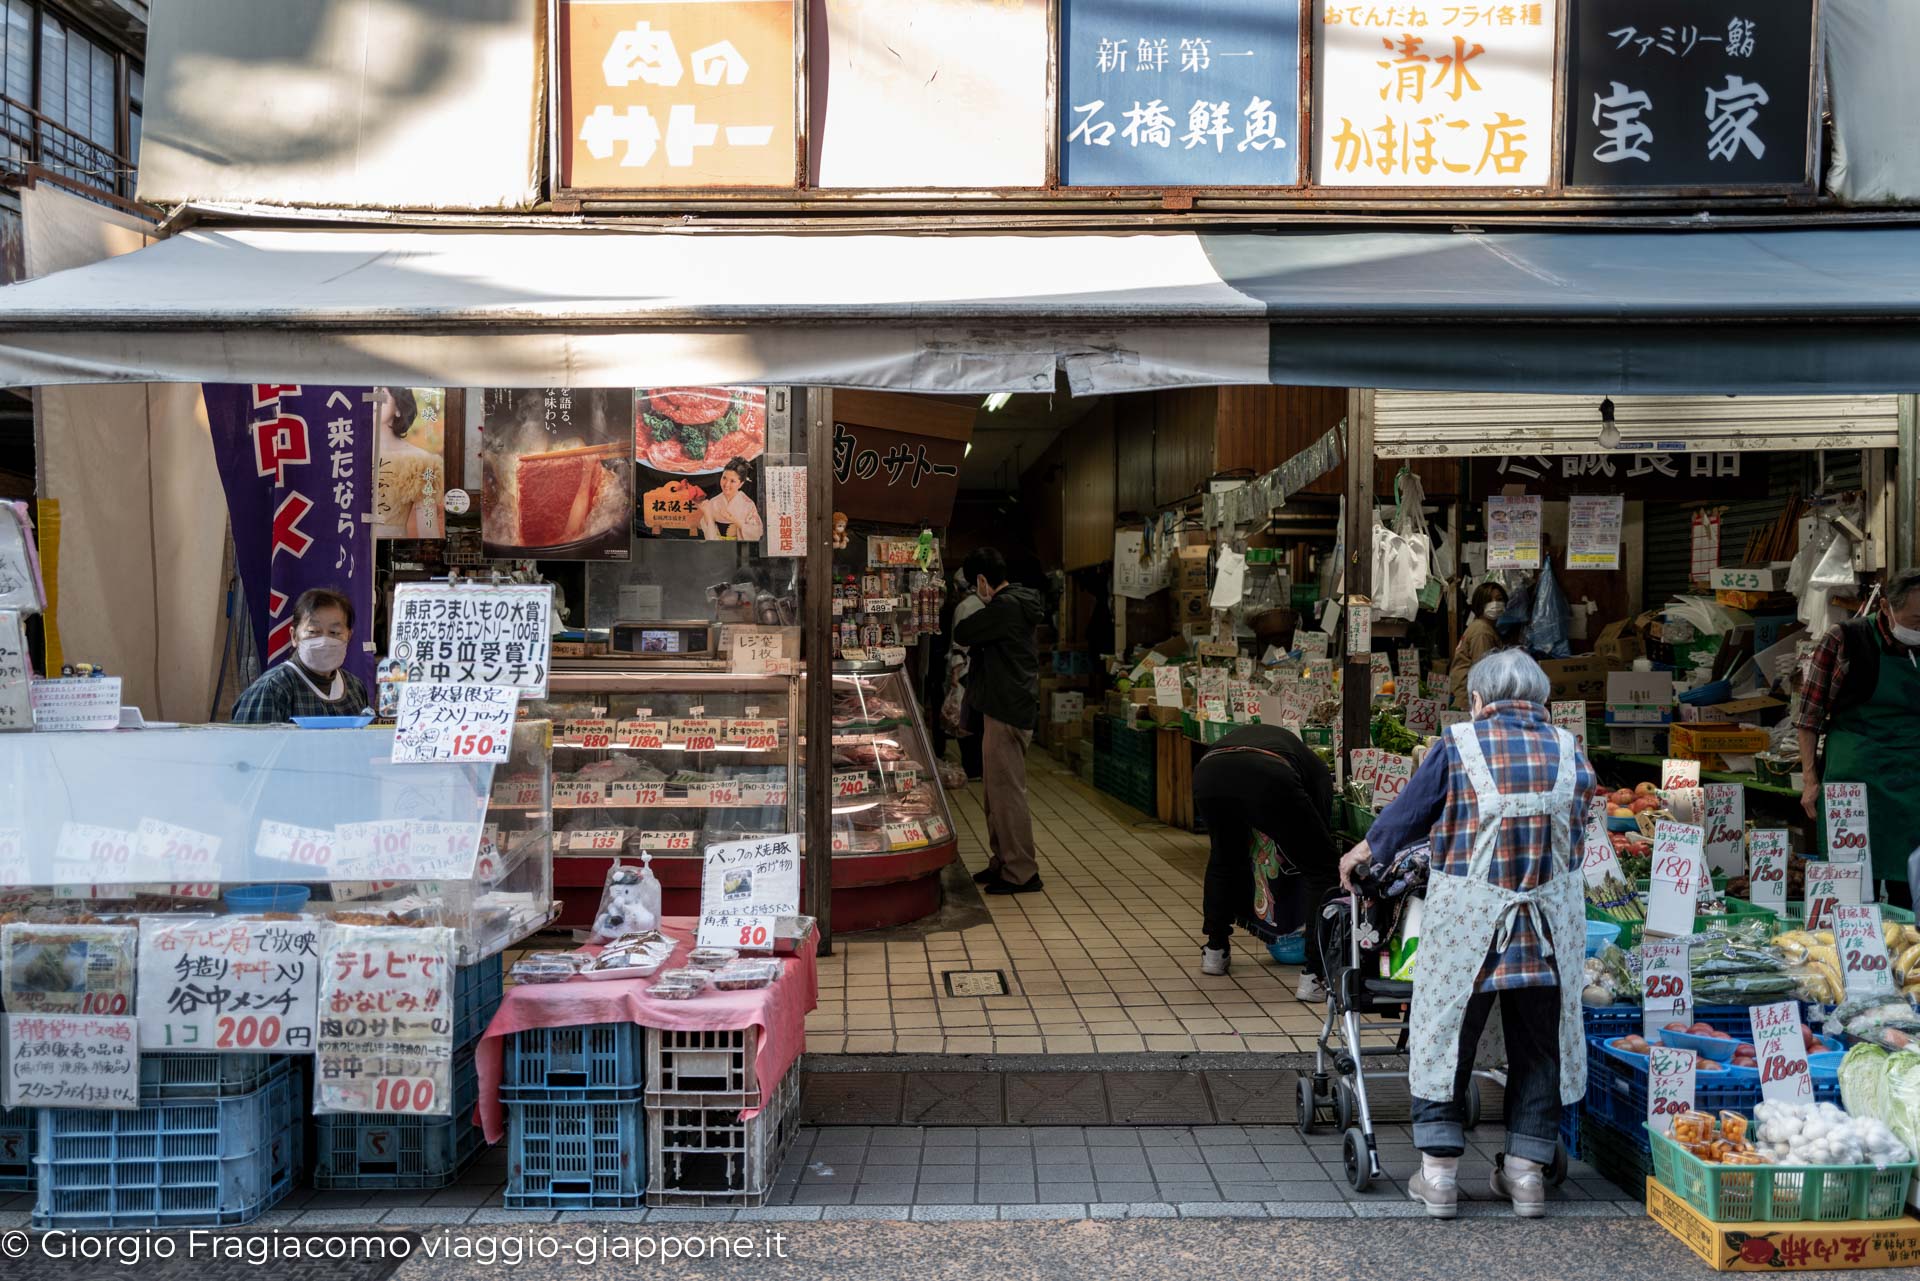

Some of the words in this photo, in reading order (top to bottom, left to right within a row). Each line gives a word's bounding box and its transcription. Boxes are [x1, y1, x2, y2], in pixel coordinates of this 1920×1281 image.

[1324, 5, 1430, 28] おでんたね
[1441, 3, 1542, 27] フライ各種
[602, 20, 750, 87] 肉の
[1095, 38, 1254, 74] 新鮮第一
[1377, 34, 1487, 104] 清水
[579, 104, 774, 167] サトー
[1066, 96, 1287, 154] 石橋鮮魚
[1331, 111, 1528, 177] かまぼこ店
[652, 499, 698, 513] 松阪牛
[780, 516, 793, 551] 加盟店
[1721, 573, 1760, 588] ぶどう
[871, 604, 886, 612] 489
[430, 686, 508, 704] 数量限定
[583, 735, 609, 747] 880
[840, 781, 863, 796] 240
[1832, 828, 1867, 849] 500
[91, 840, 130, 863] 100
[1656, 856, 1692, 877] 180
[1751, 865, 1784, 882] 150
[336, 951, 445, 981] テレビで
[1847, 950, 1887, 972] 200
[1645, 974, 1684, 998] 250
[82, 991, 127, 1016] 100
[167, 983, 299, 1016] 谷中メンチ
[1758, 1025, 1798, 1040] にんにく
[376, 1078, 435, 1111] 100
[1651, 1097, 1691, 1115] 200
